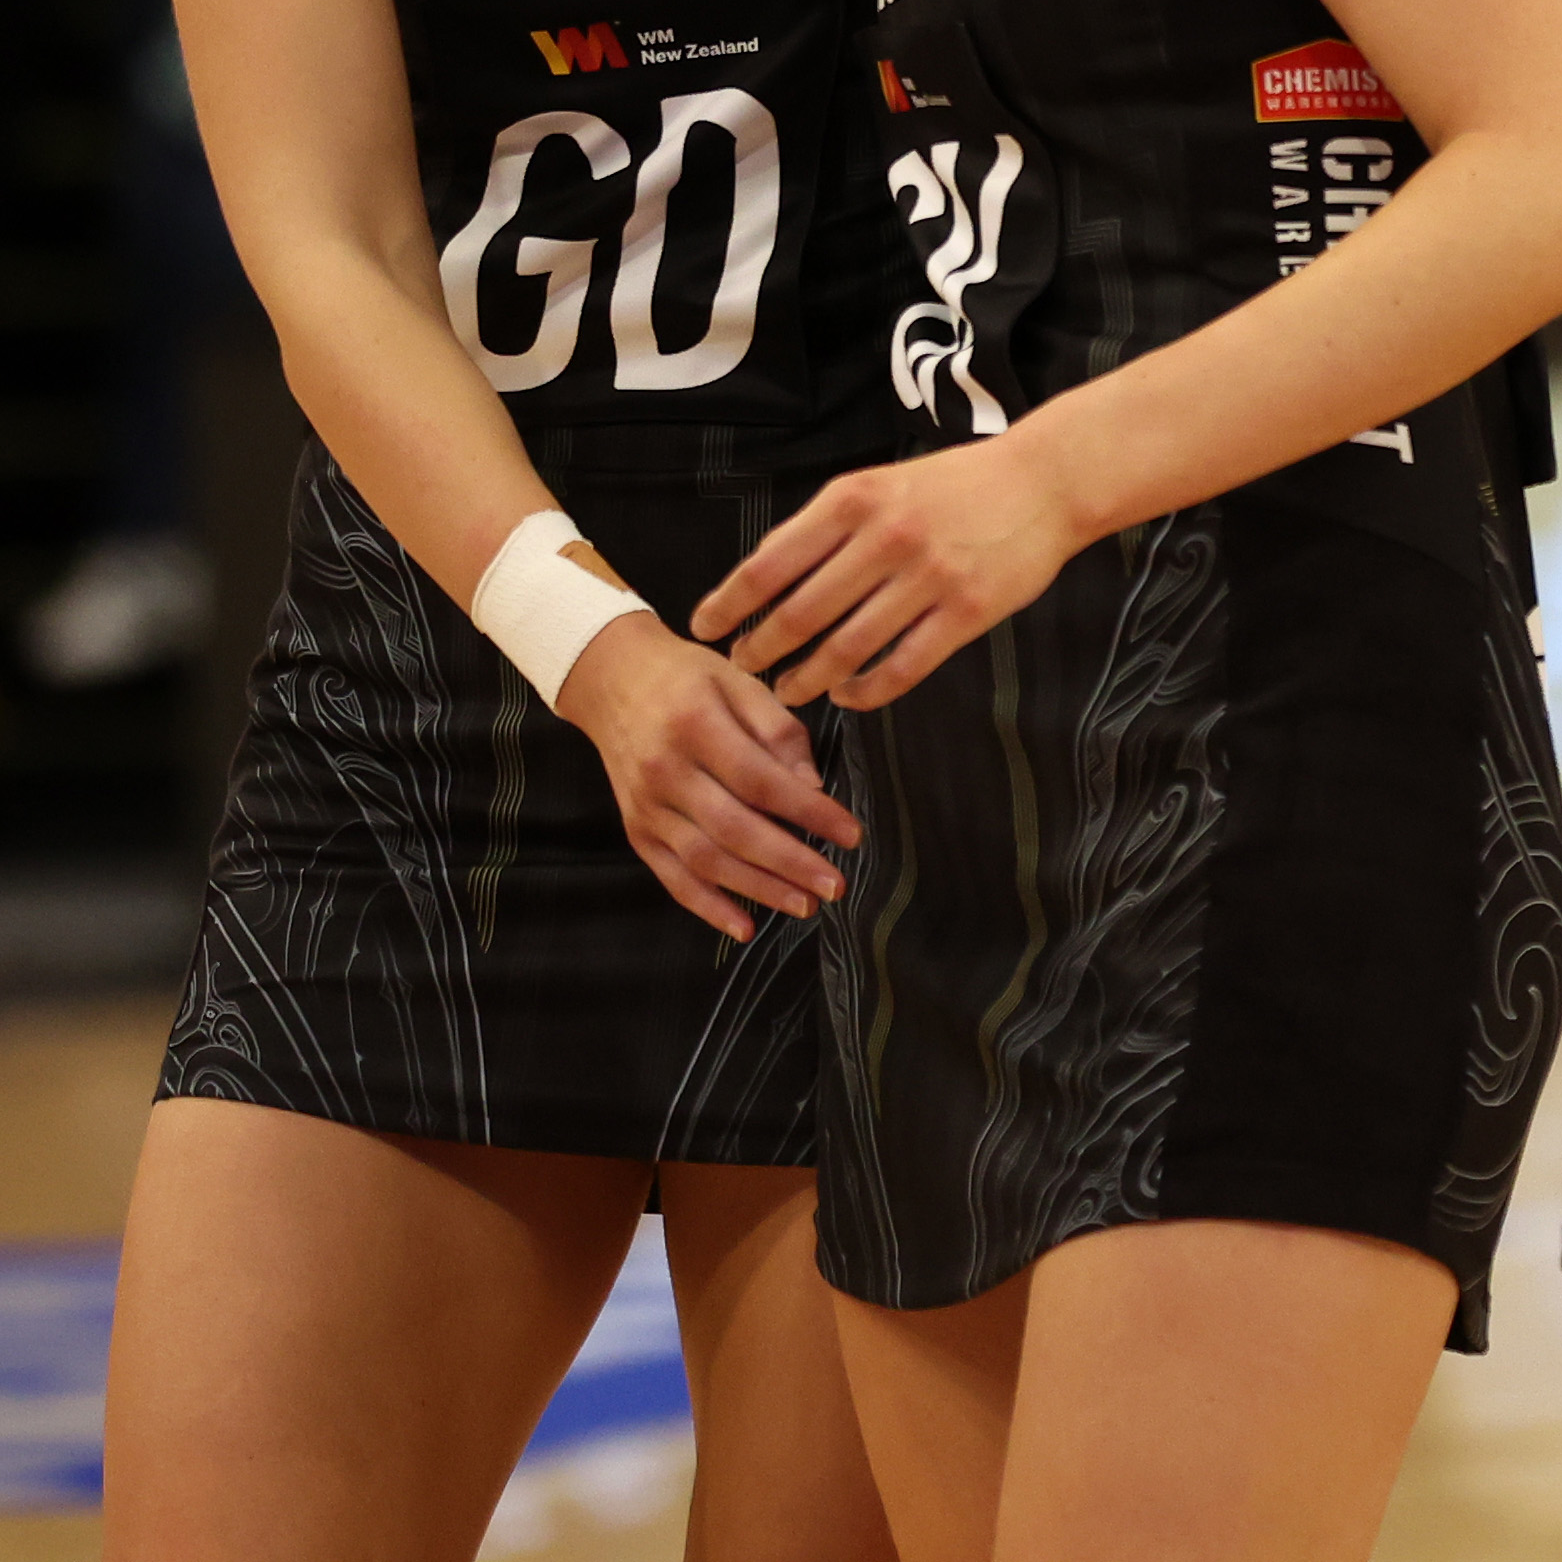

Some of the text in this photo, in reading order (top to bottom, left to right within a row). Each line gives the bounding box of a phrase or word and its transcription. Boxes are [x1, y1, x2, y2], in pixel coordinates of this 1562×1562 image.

[637, 28, 676, 46] WM
[640, 37, 760, 66] New Zealand
[1263, 68, 1379, 94] CHEMIS
[438, 86, 781, 393] GD
